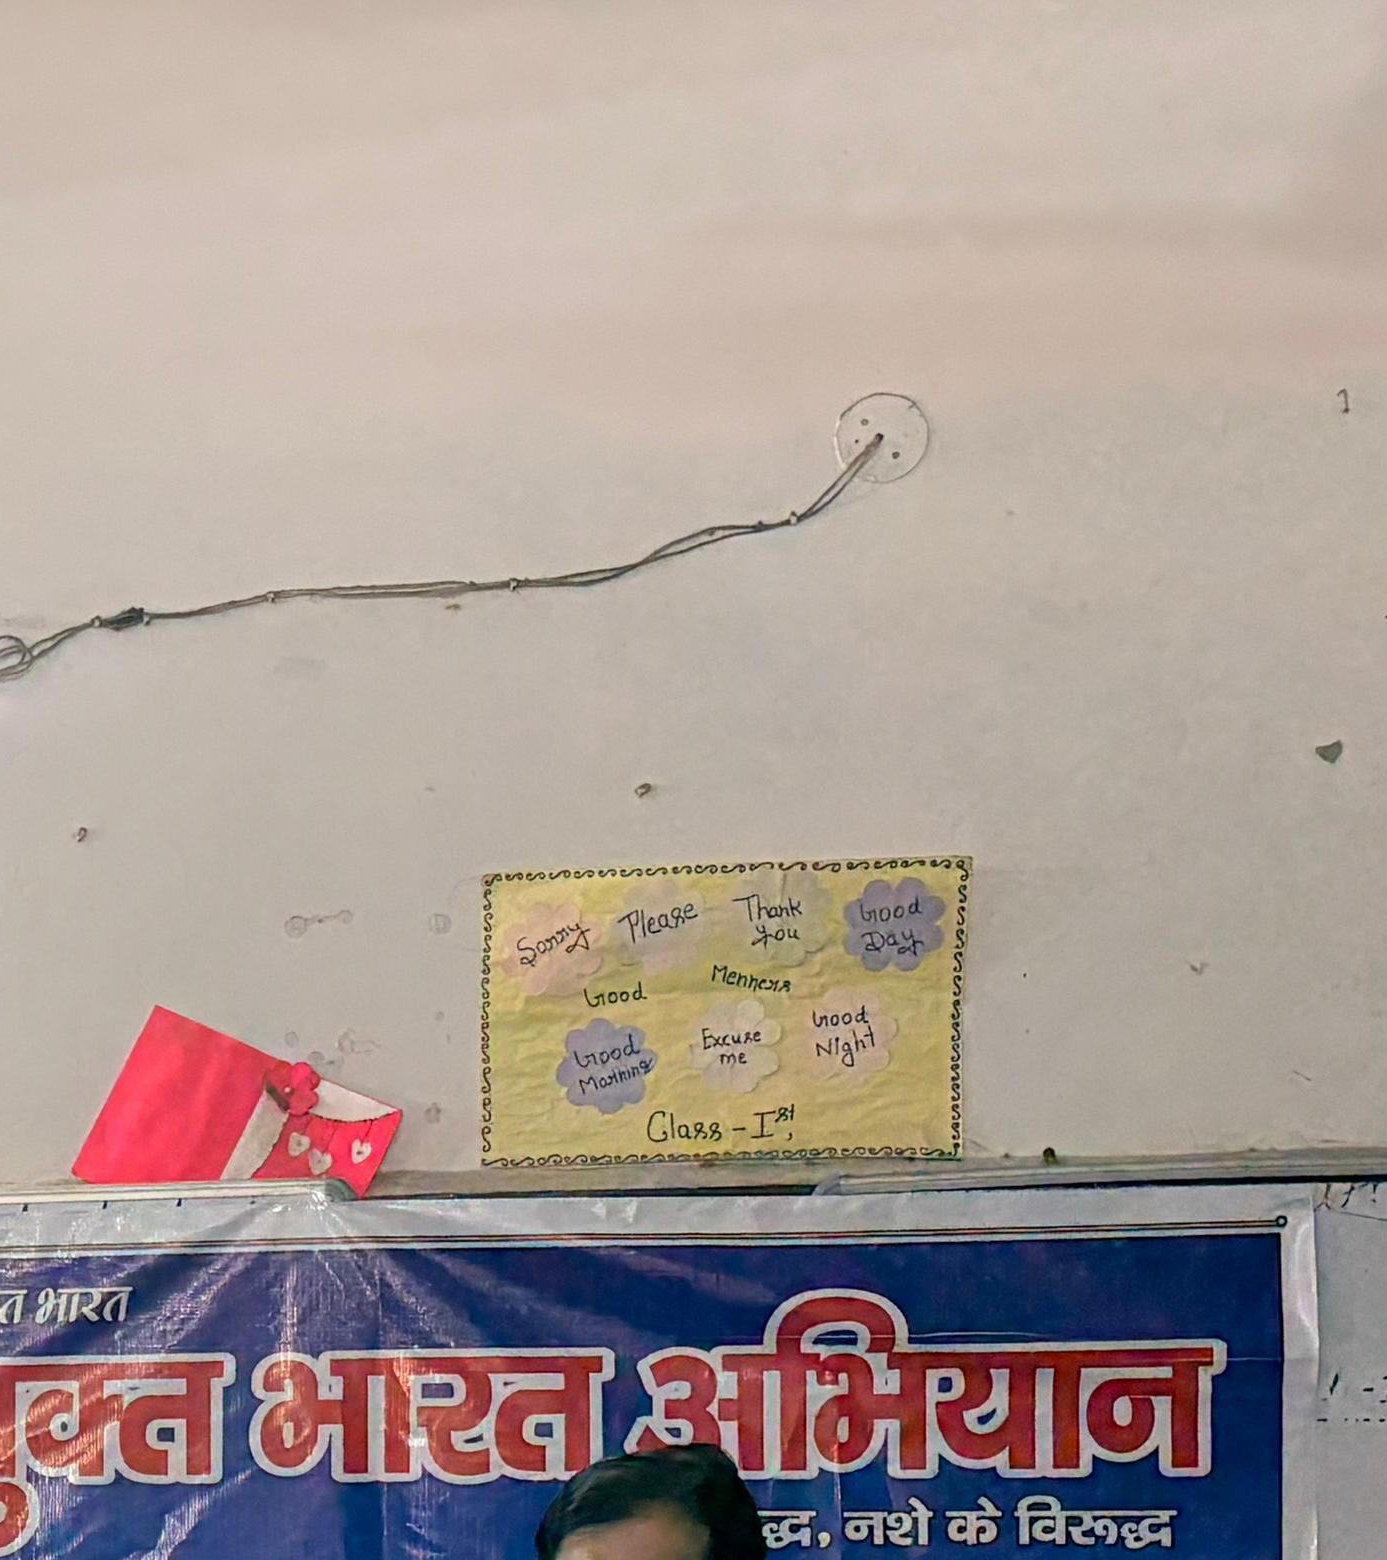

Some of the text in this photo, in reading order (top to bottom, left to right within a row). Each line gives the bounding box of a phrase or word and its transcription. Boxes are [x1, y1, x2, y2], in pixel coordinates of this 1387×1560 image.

[617, 900, 699, 945] Please
[733, 894, 803, 922] Thank
[859, 930, 925, 958] Day
[583, 981, 648, 1008] Good
[812, 1004, 869, 1027] Good
[573, 1033, 641, 1069] Good
[718, 1049, 748, 1066] me
[34, 1285, 134, 1326] भारत
[250, 1346, 616, 1488] भारत
[626, 1287, 1227, 1482] अभियान
[842, 1495, 934, 1549] नशे
[945, 1495, 1003, 1548] के
